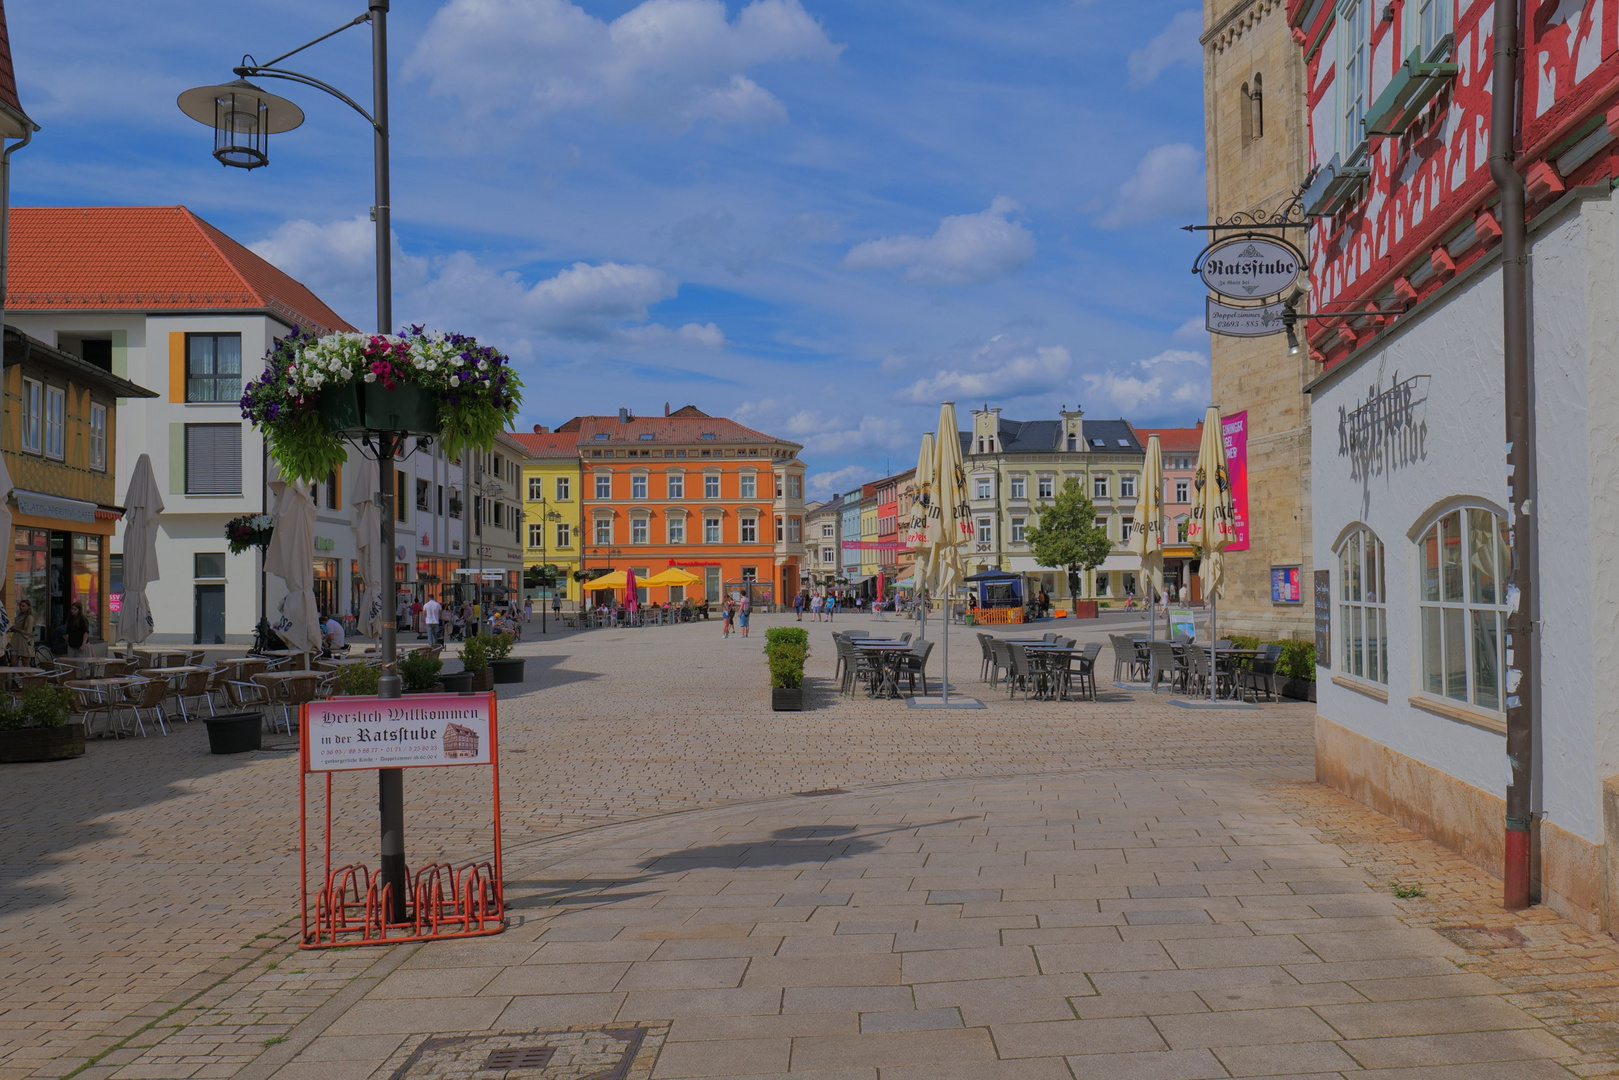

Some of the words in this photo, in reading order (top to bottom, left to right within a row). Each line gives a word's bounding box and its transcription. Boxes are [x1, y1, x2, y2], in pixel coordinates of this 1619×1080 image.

[1213, 311, 1260, 319] Doppelzimmer
[322, 709, 381, 726] Herzlich
[388, 708, 478, 721] Willkommen
[321, 735, 331, 744] in
[335, 735, 351, 744] der
